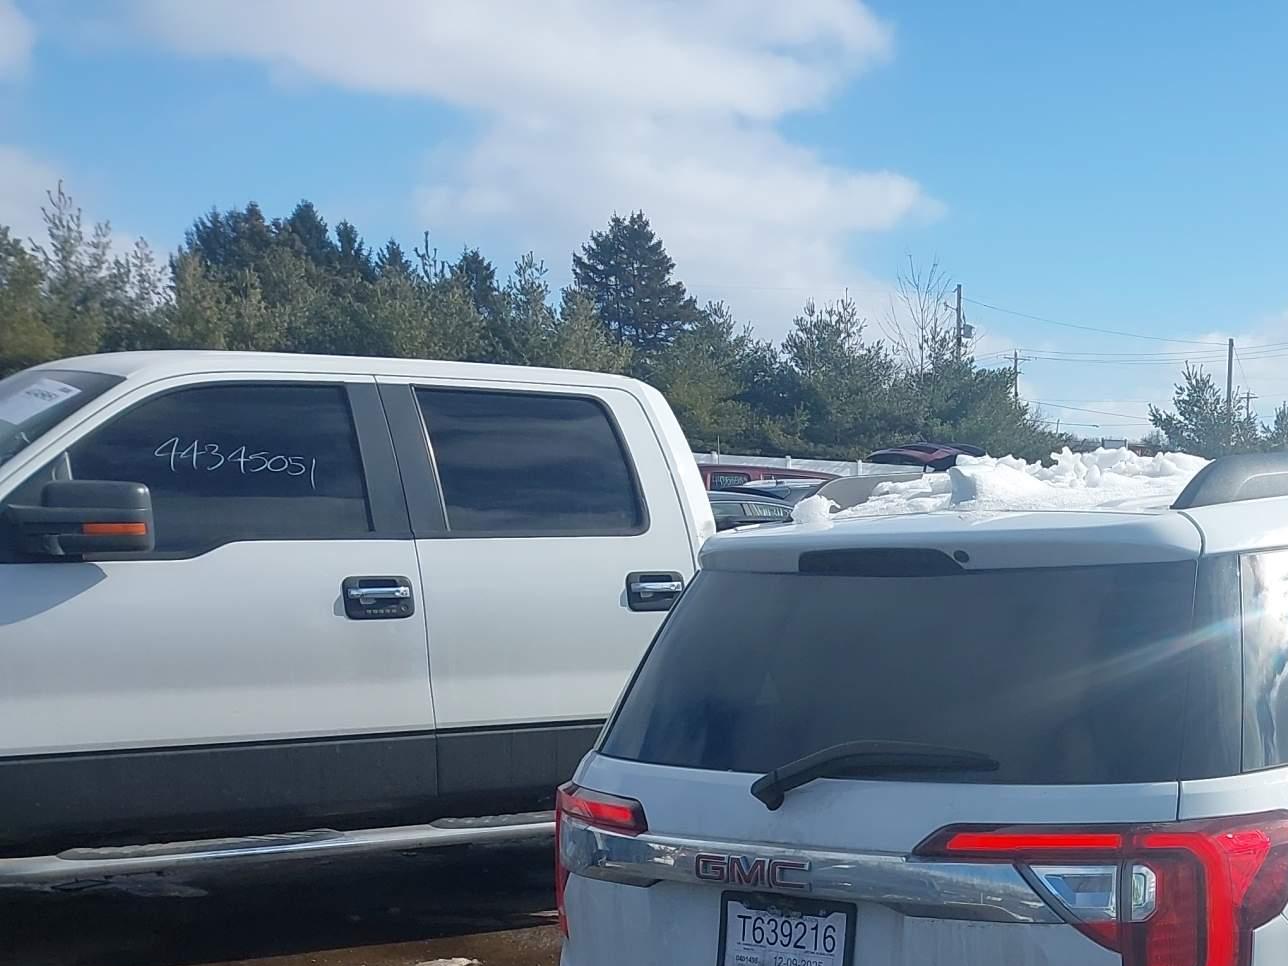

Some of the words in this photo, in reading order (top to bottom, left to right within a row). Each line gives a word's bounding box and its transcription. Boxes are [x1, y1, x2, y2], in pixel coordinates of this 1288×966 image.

[153, 436, 319, 490] 44345051
[695, 852, 813, 891] GMC
[736, 914, 837, 954] T639216
